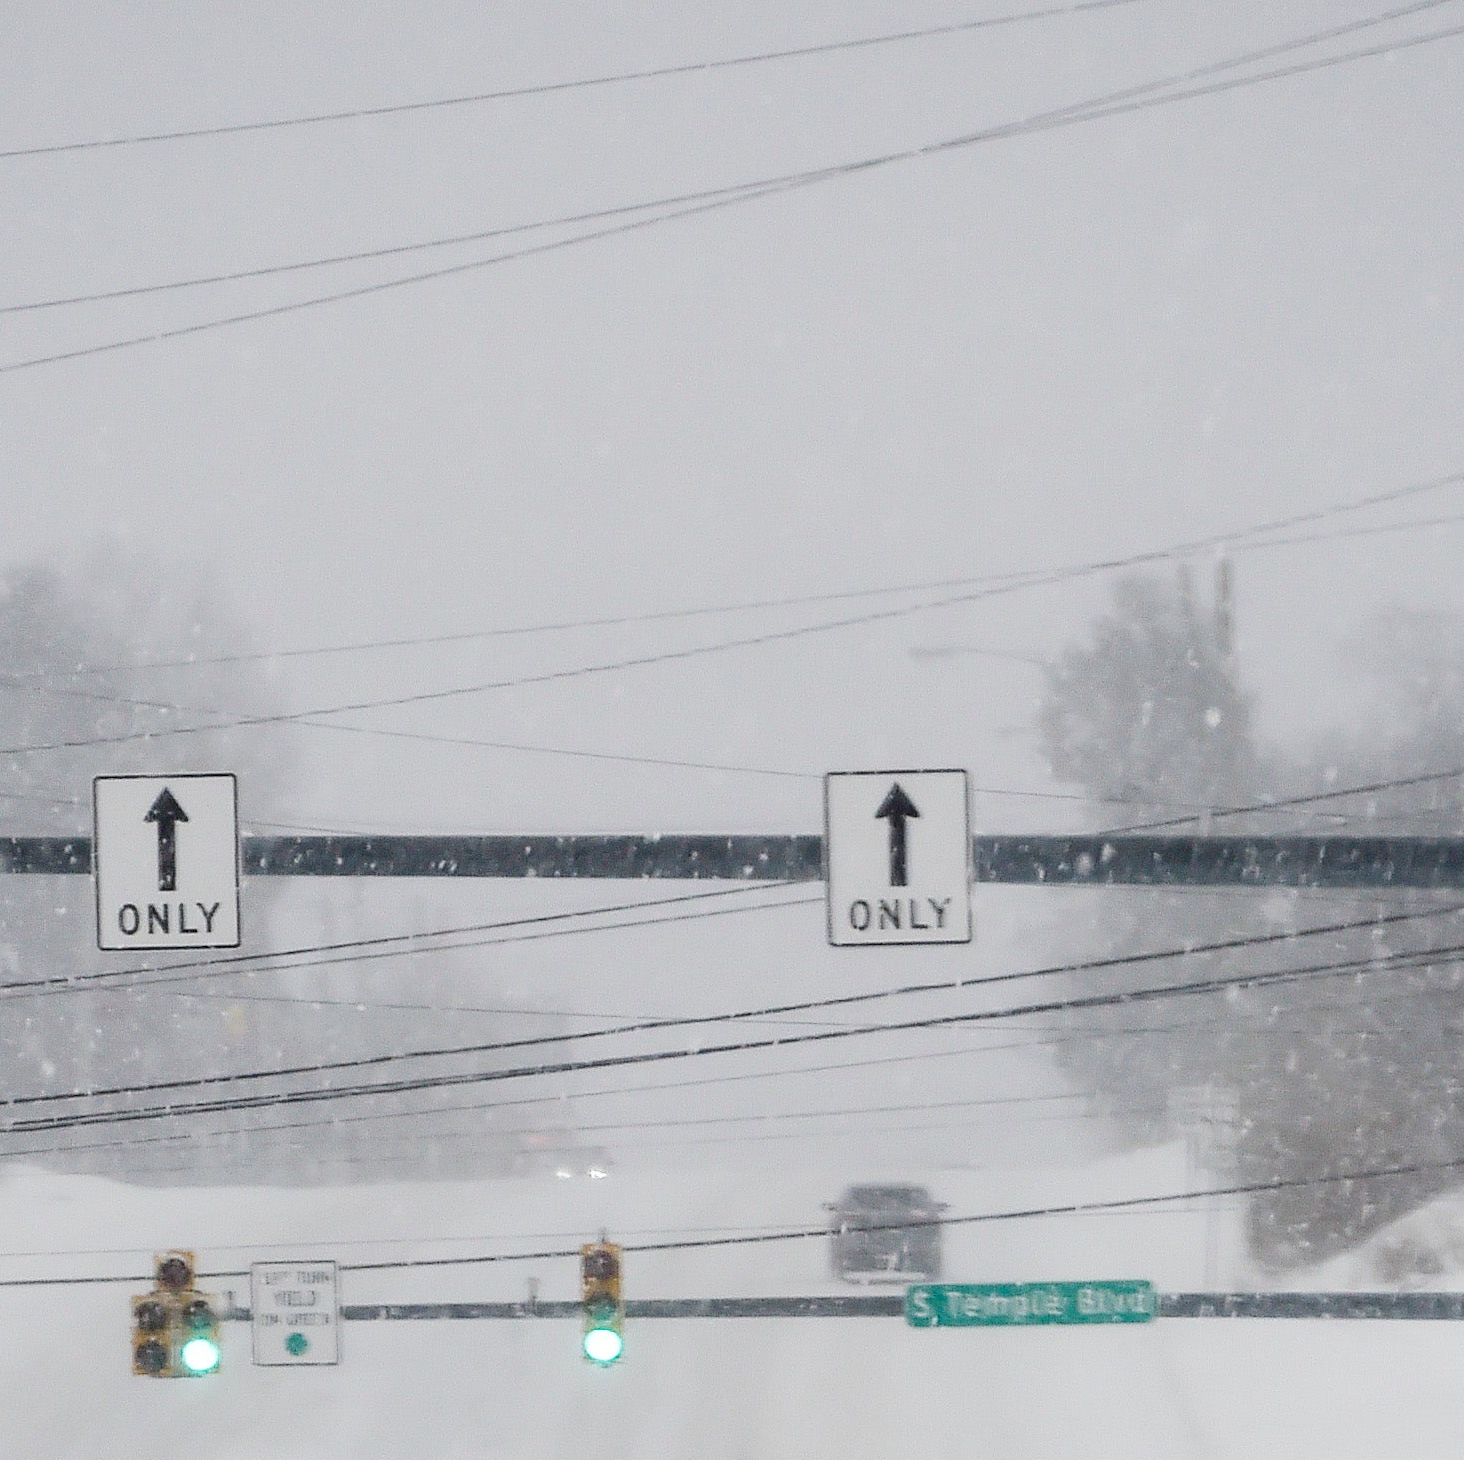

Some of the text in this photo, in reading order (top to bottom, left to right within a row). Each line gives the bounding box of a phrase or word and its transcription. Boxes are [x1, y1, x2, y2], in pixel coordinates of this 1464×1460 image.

[118, 901, 220, 935] ONLY
[849, 897, 951, 931] ONLY
[911, 1287, 1152, 1321] S Temple Blvd
